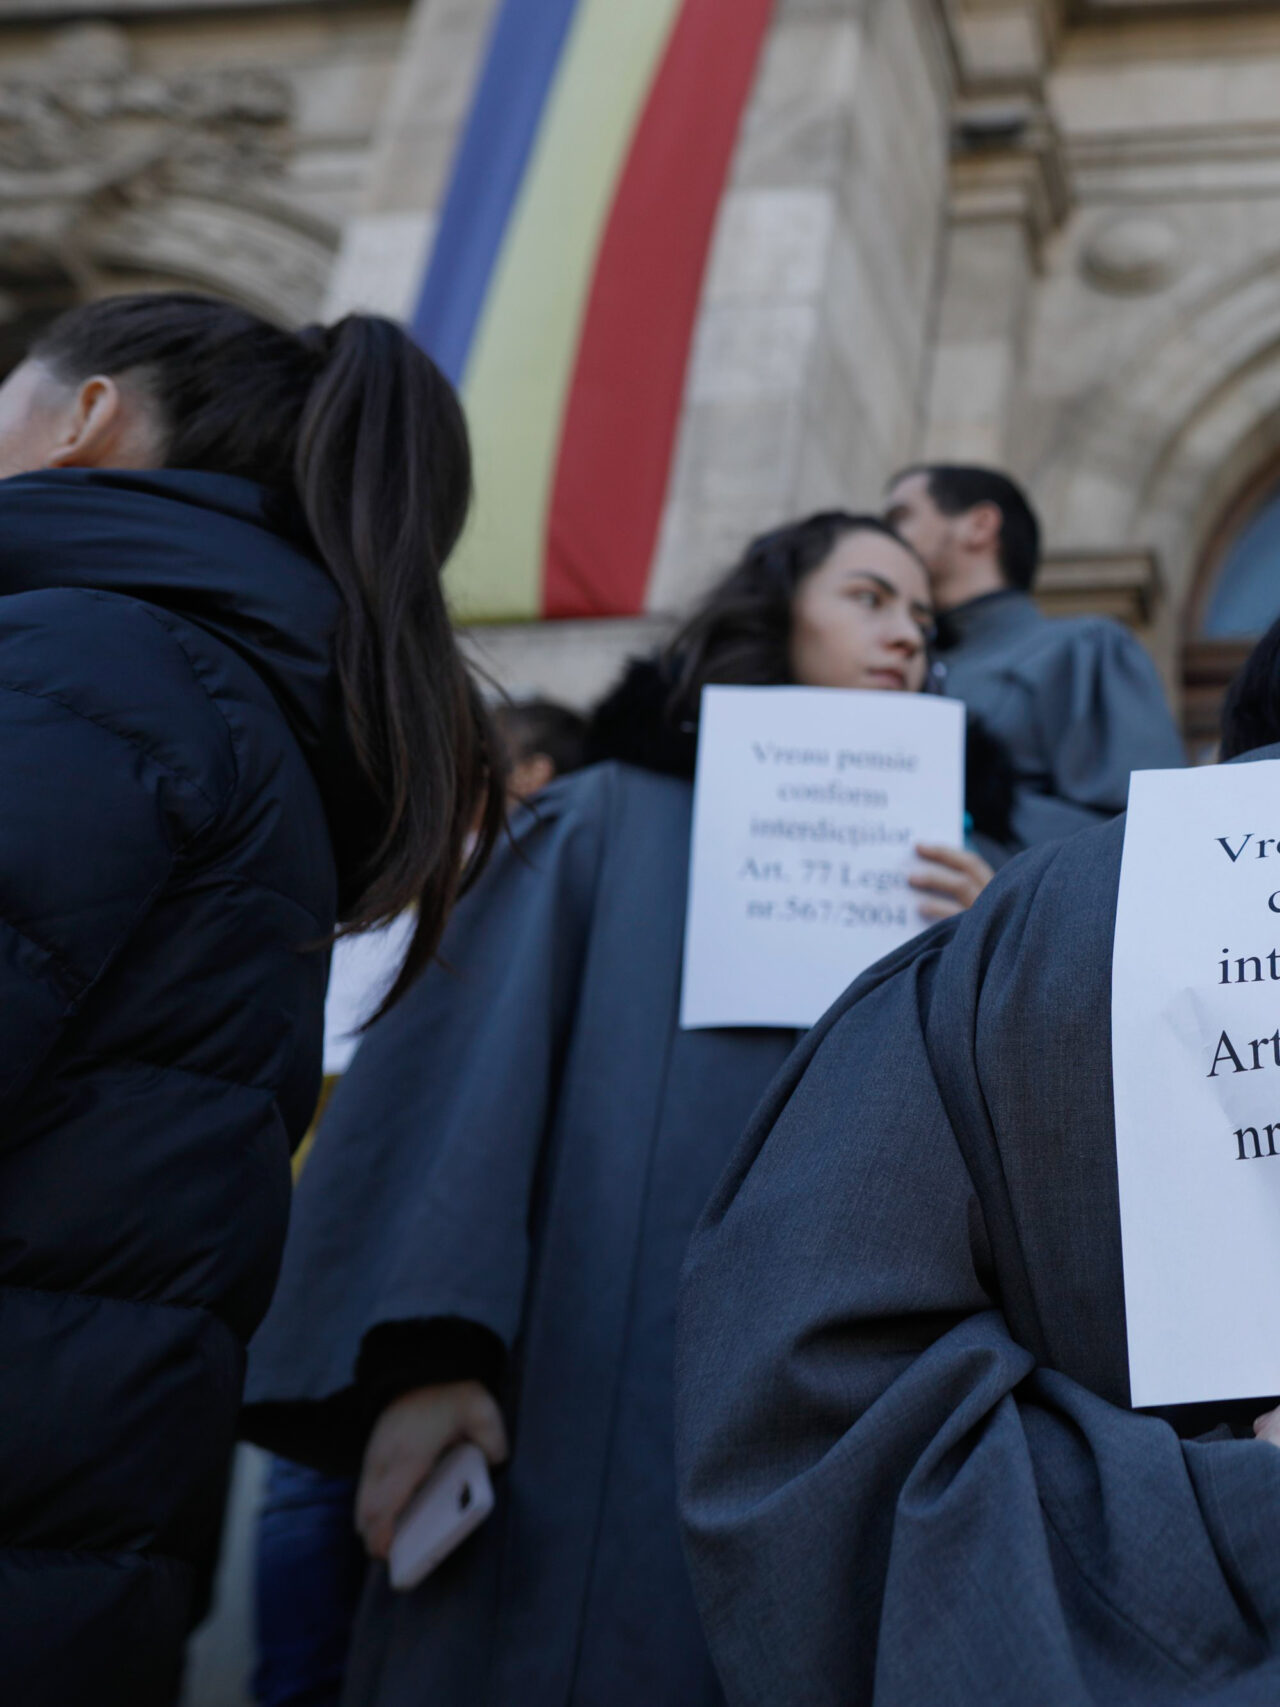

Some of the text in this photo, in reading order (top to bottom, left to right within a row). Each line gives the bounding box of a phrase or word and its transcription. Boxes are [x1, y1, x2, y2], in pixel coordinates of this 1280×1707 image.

[752, 742, 917, 772] Vreau pensie
[801, 860, 832, 882] 77
